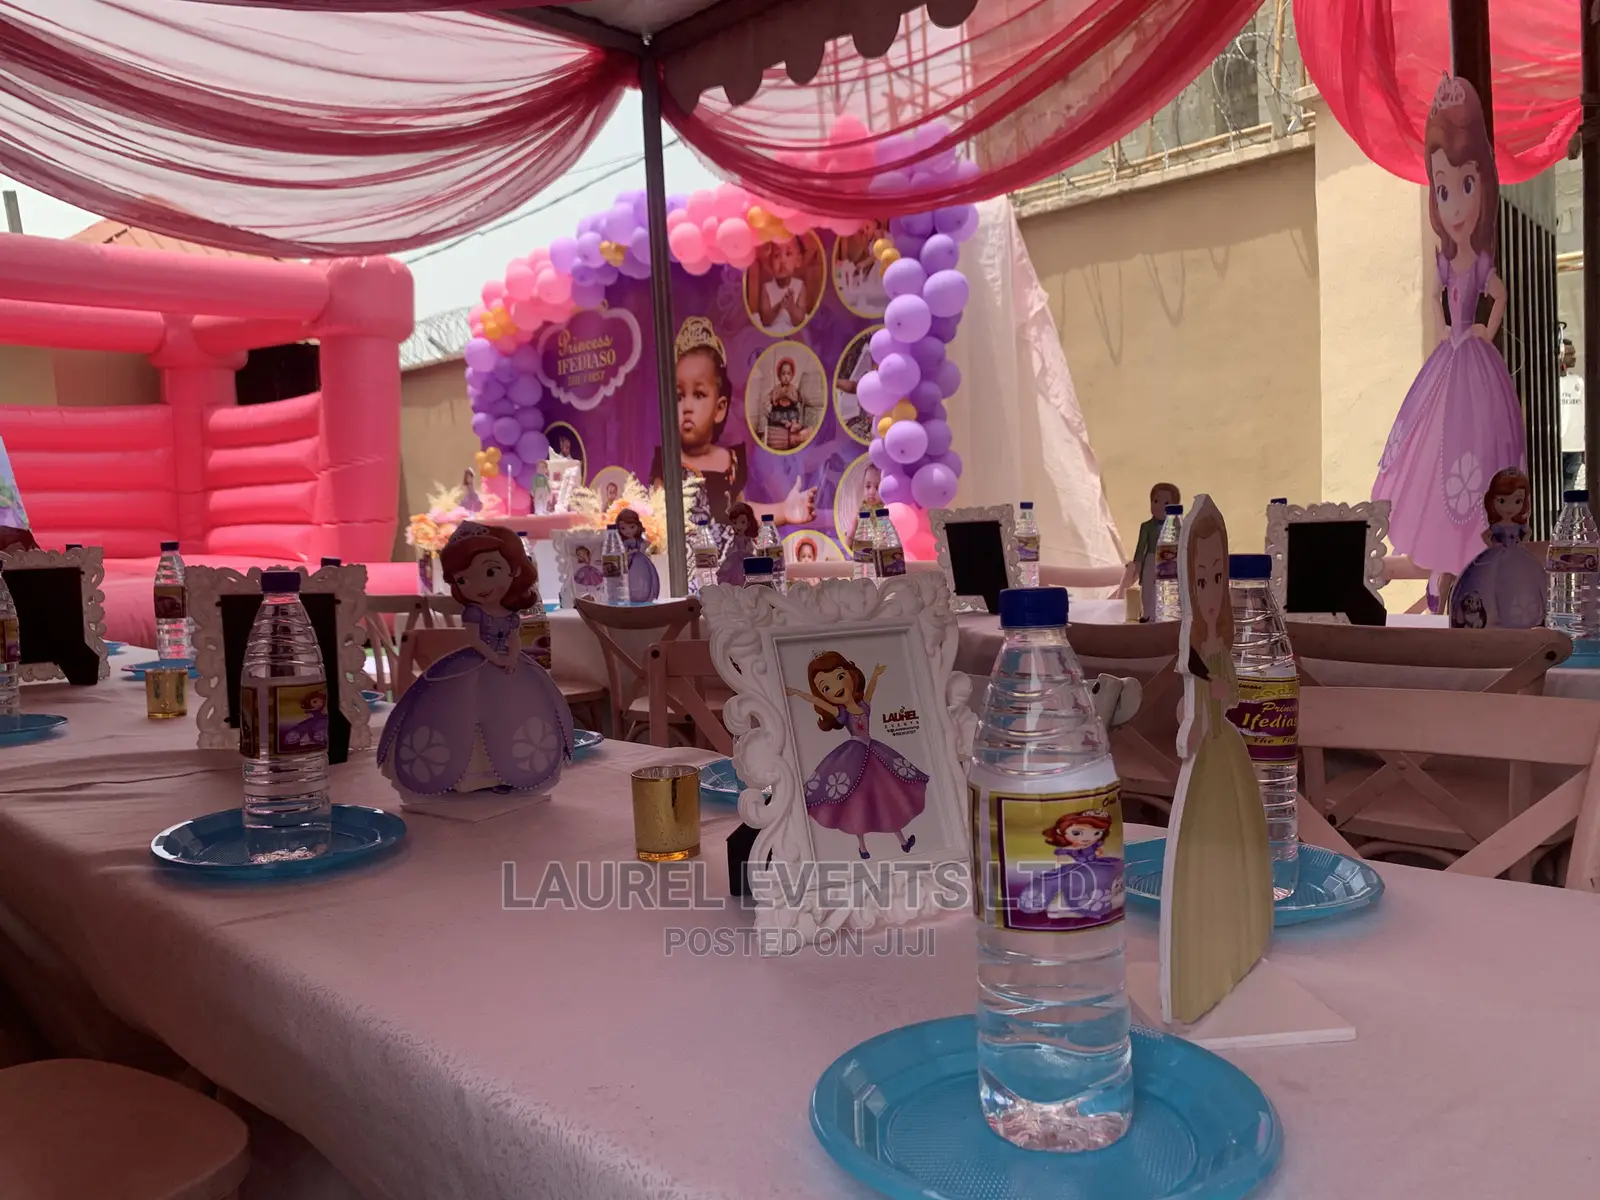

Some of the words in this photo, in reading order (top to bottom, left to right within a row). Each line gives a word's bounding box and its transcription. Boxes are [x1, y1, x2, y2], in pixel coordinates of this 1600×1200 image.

[558, 329, 613, 357] Princess
[557, 348, 616, 376] IFEDIASO
[882, 709, 919, 723] LAUREL
